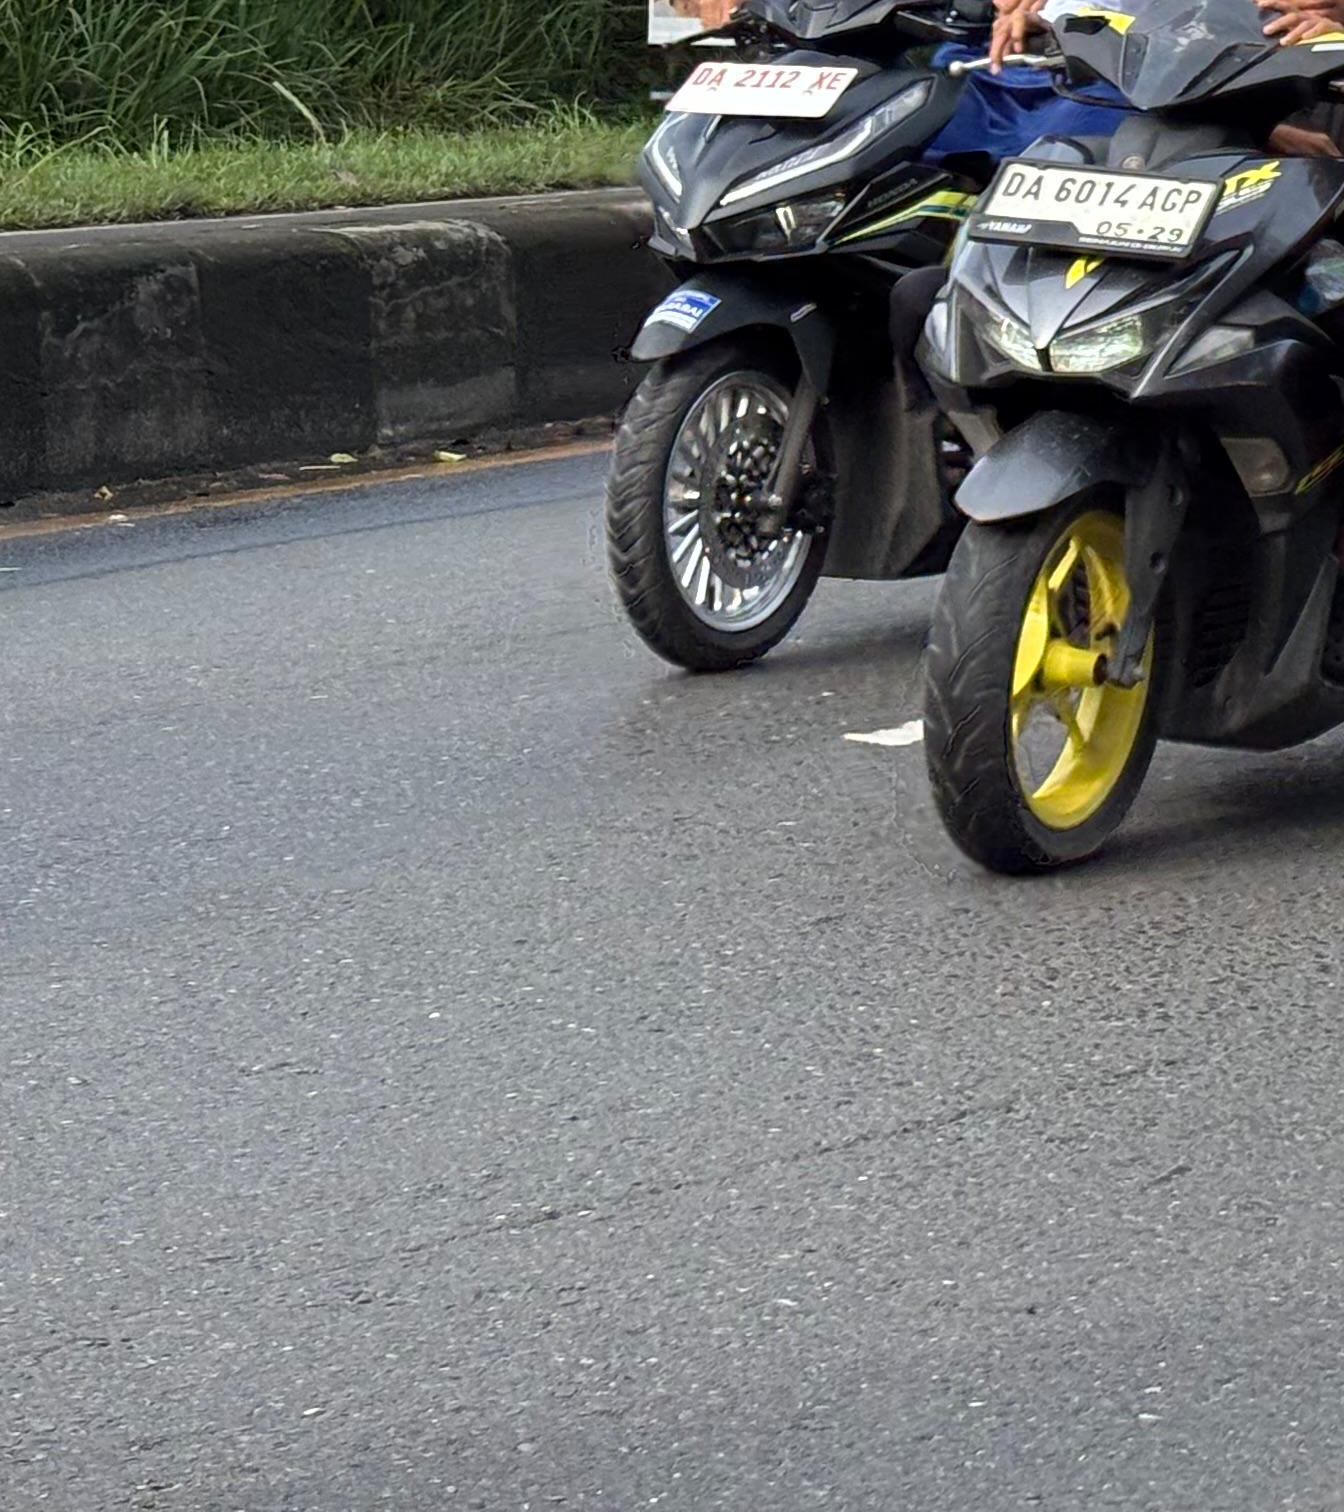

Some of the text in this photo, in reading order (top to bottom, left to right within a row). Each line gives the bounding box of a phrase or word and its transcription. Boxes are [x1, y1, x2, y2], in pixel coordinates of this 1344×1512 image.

[692, 68, 847, 90] DA 2112 XE
[1001, 172, 1041, 202] DA
[1053, 177, 1137, 208] 6014
